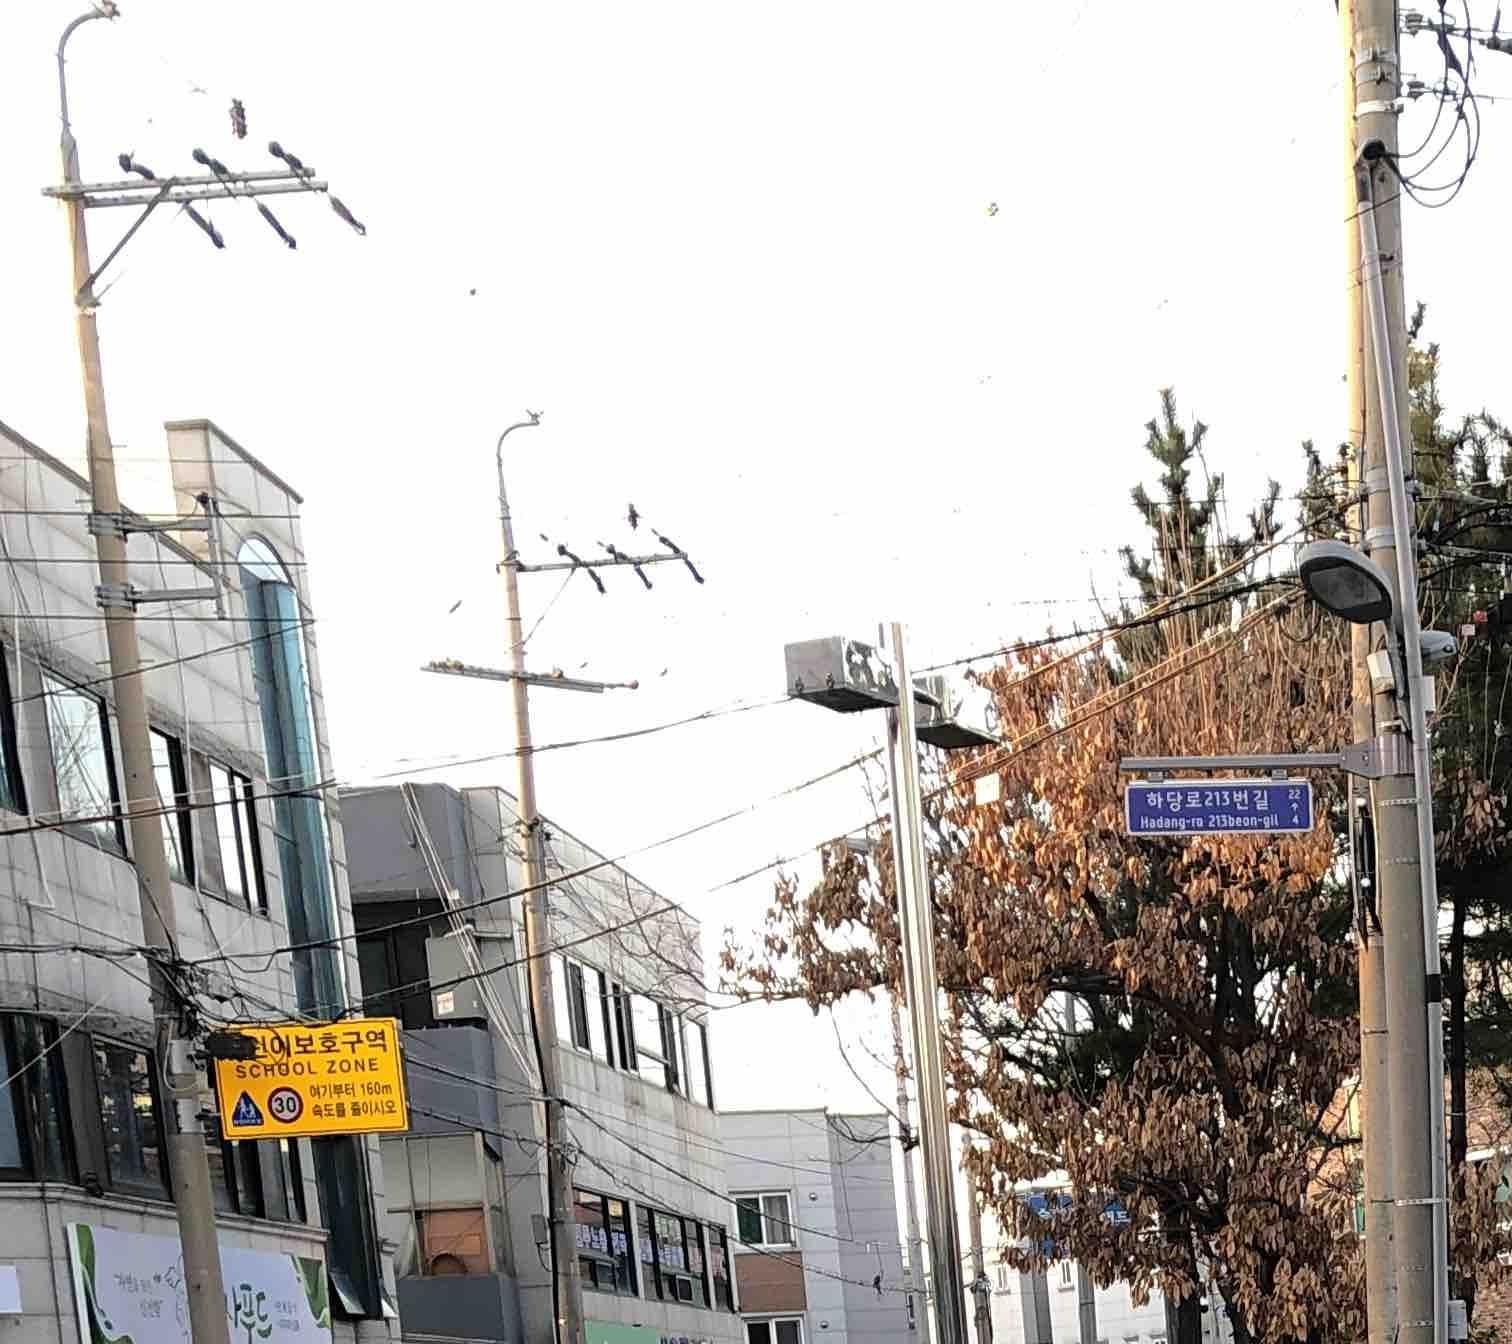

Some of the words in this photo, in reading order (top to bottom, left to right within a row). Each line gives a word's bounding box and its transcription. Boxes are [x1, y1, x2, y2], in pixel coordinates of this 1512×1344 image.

[1146, 789, 1270, 812] 하당로213번길
[1287, 790, 1301, 800] 22
[1292, 815, 1299, 825] 4
[250, 1028, 388, 1060] 린이보호구역
[235, 1060, 318, 1080] SCHOOL
[327, 1058, 379, 1074] ZONE
[309, 1082, 356, 1099] 여기부터
[361, 1082, 392, 1095] 160m
[274, 1096, 297, 1114] 30
[350, 1100, 397, 1117] 줄이시오
